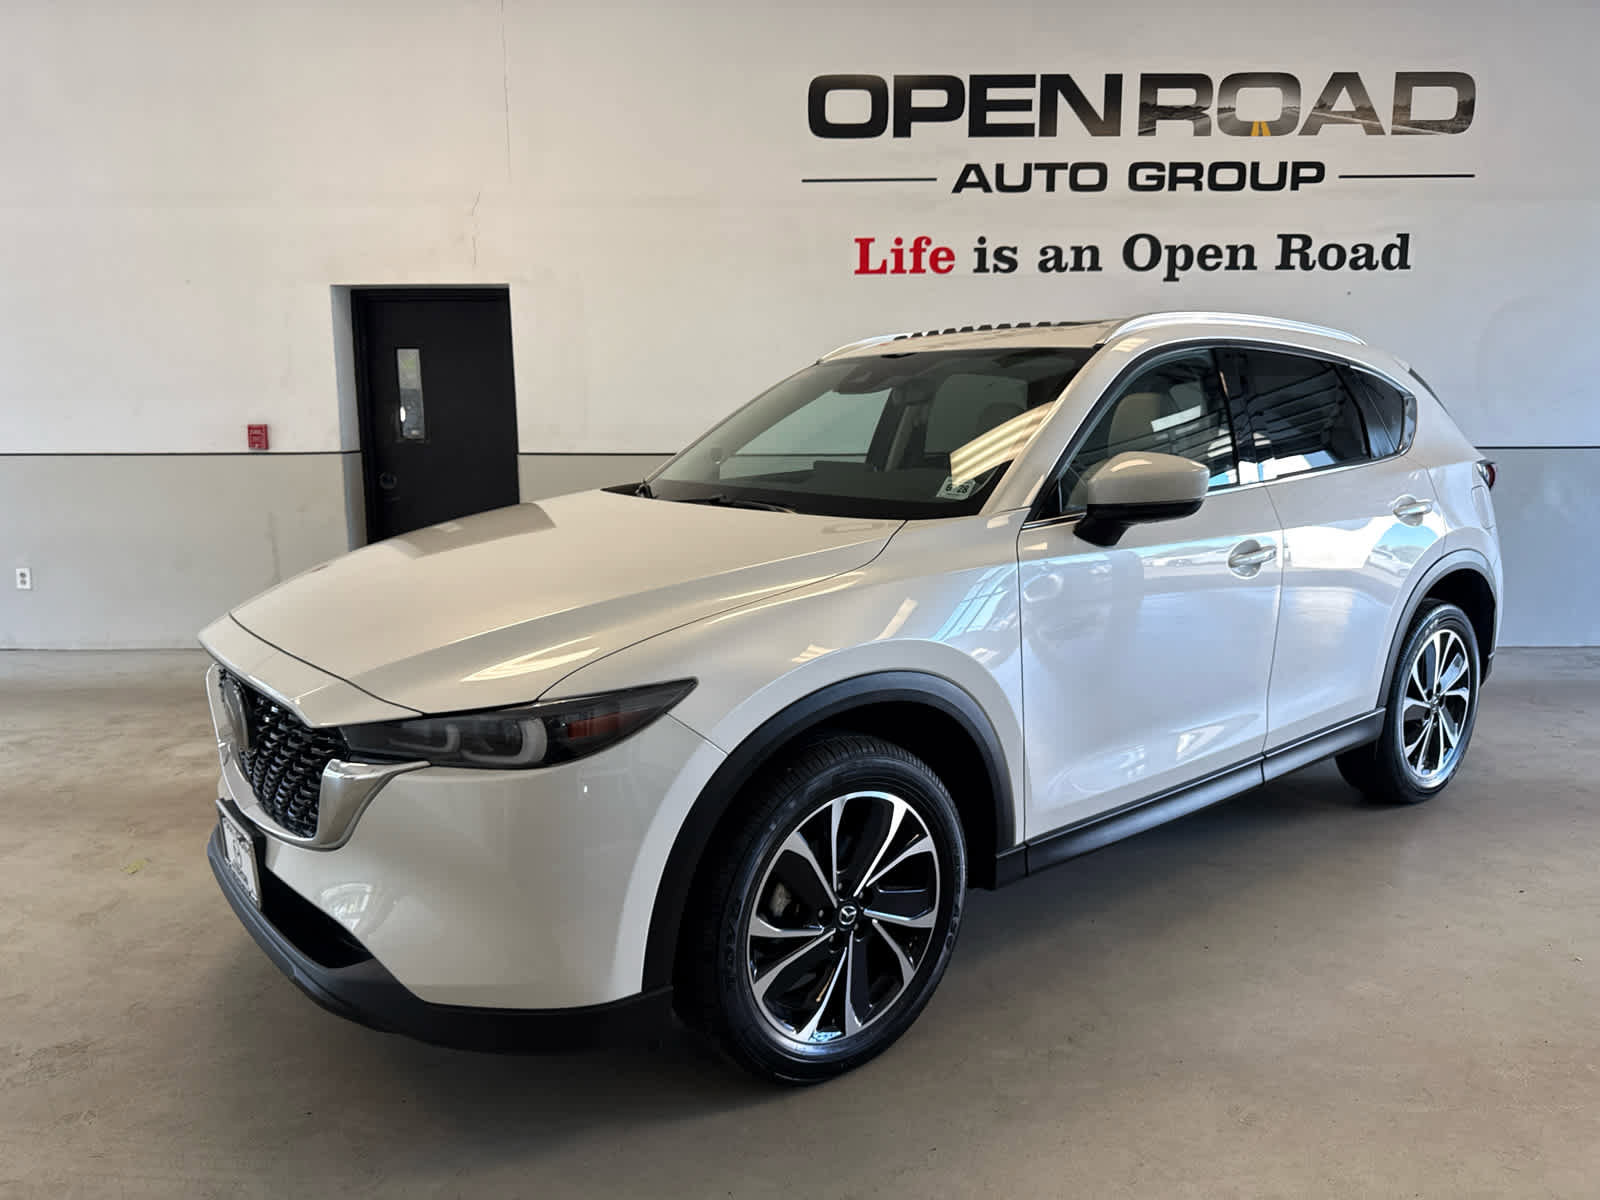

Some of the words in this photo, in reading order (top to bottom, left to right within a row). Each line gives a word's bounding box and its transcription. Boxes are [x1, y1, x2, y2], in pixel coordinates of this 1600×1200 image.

[807, 73, 1124, 139] OPEN
[1137, 71, 1477, 137] ROAD
[951, 161, 1108, 194] AUTO
[1127, 161, 1326, 192] GROUP
[854, 235, 956, 275] Life
[972, 235, 1019, 274] is
[1037, 244, 1103, 274] an
[1122, 233, 1258, 282] Open
[1274, 233, 1411, 271] Road
